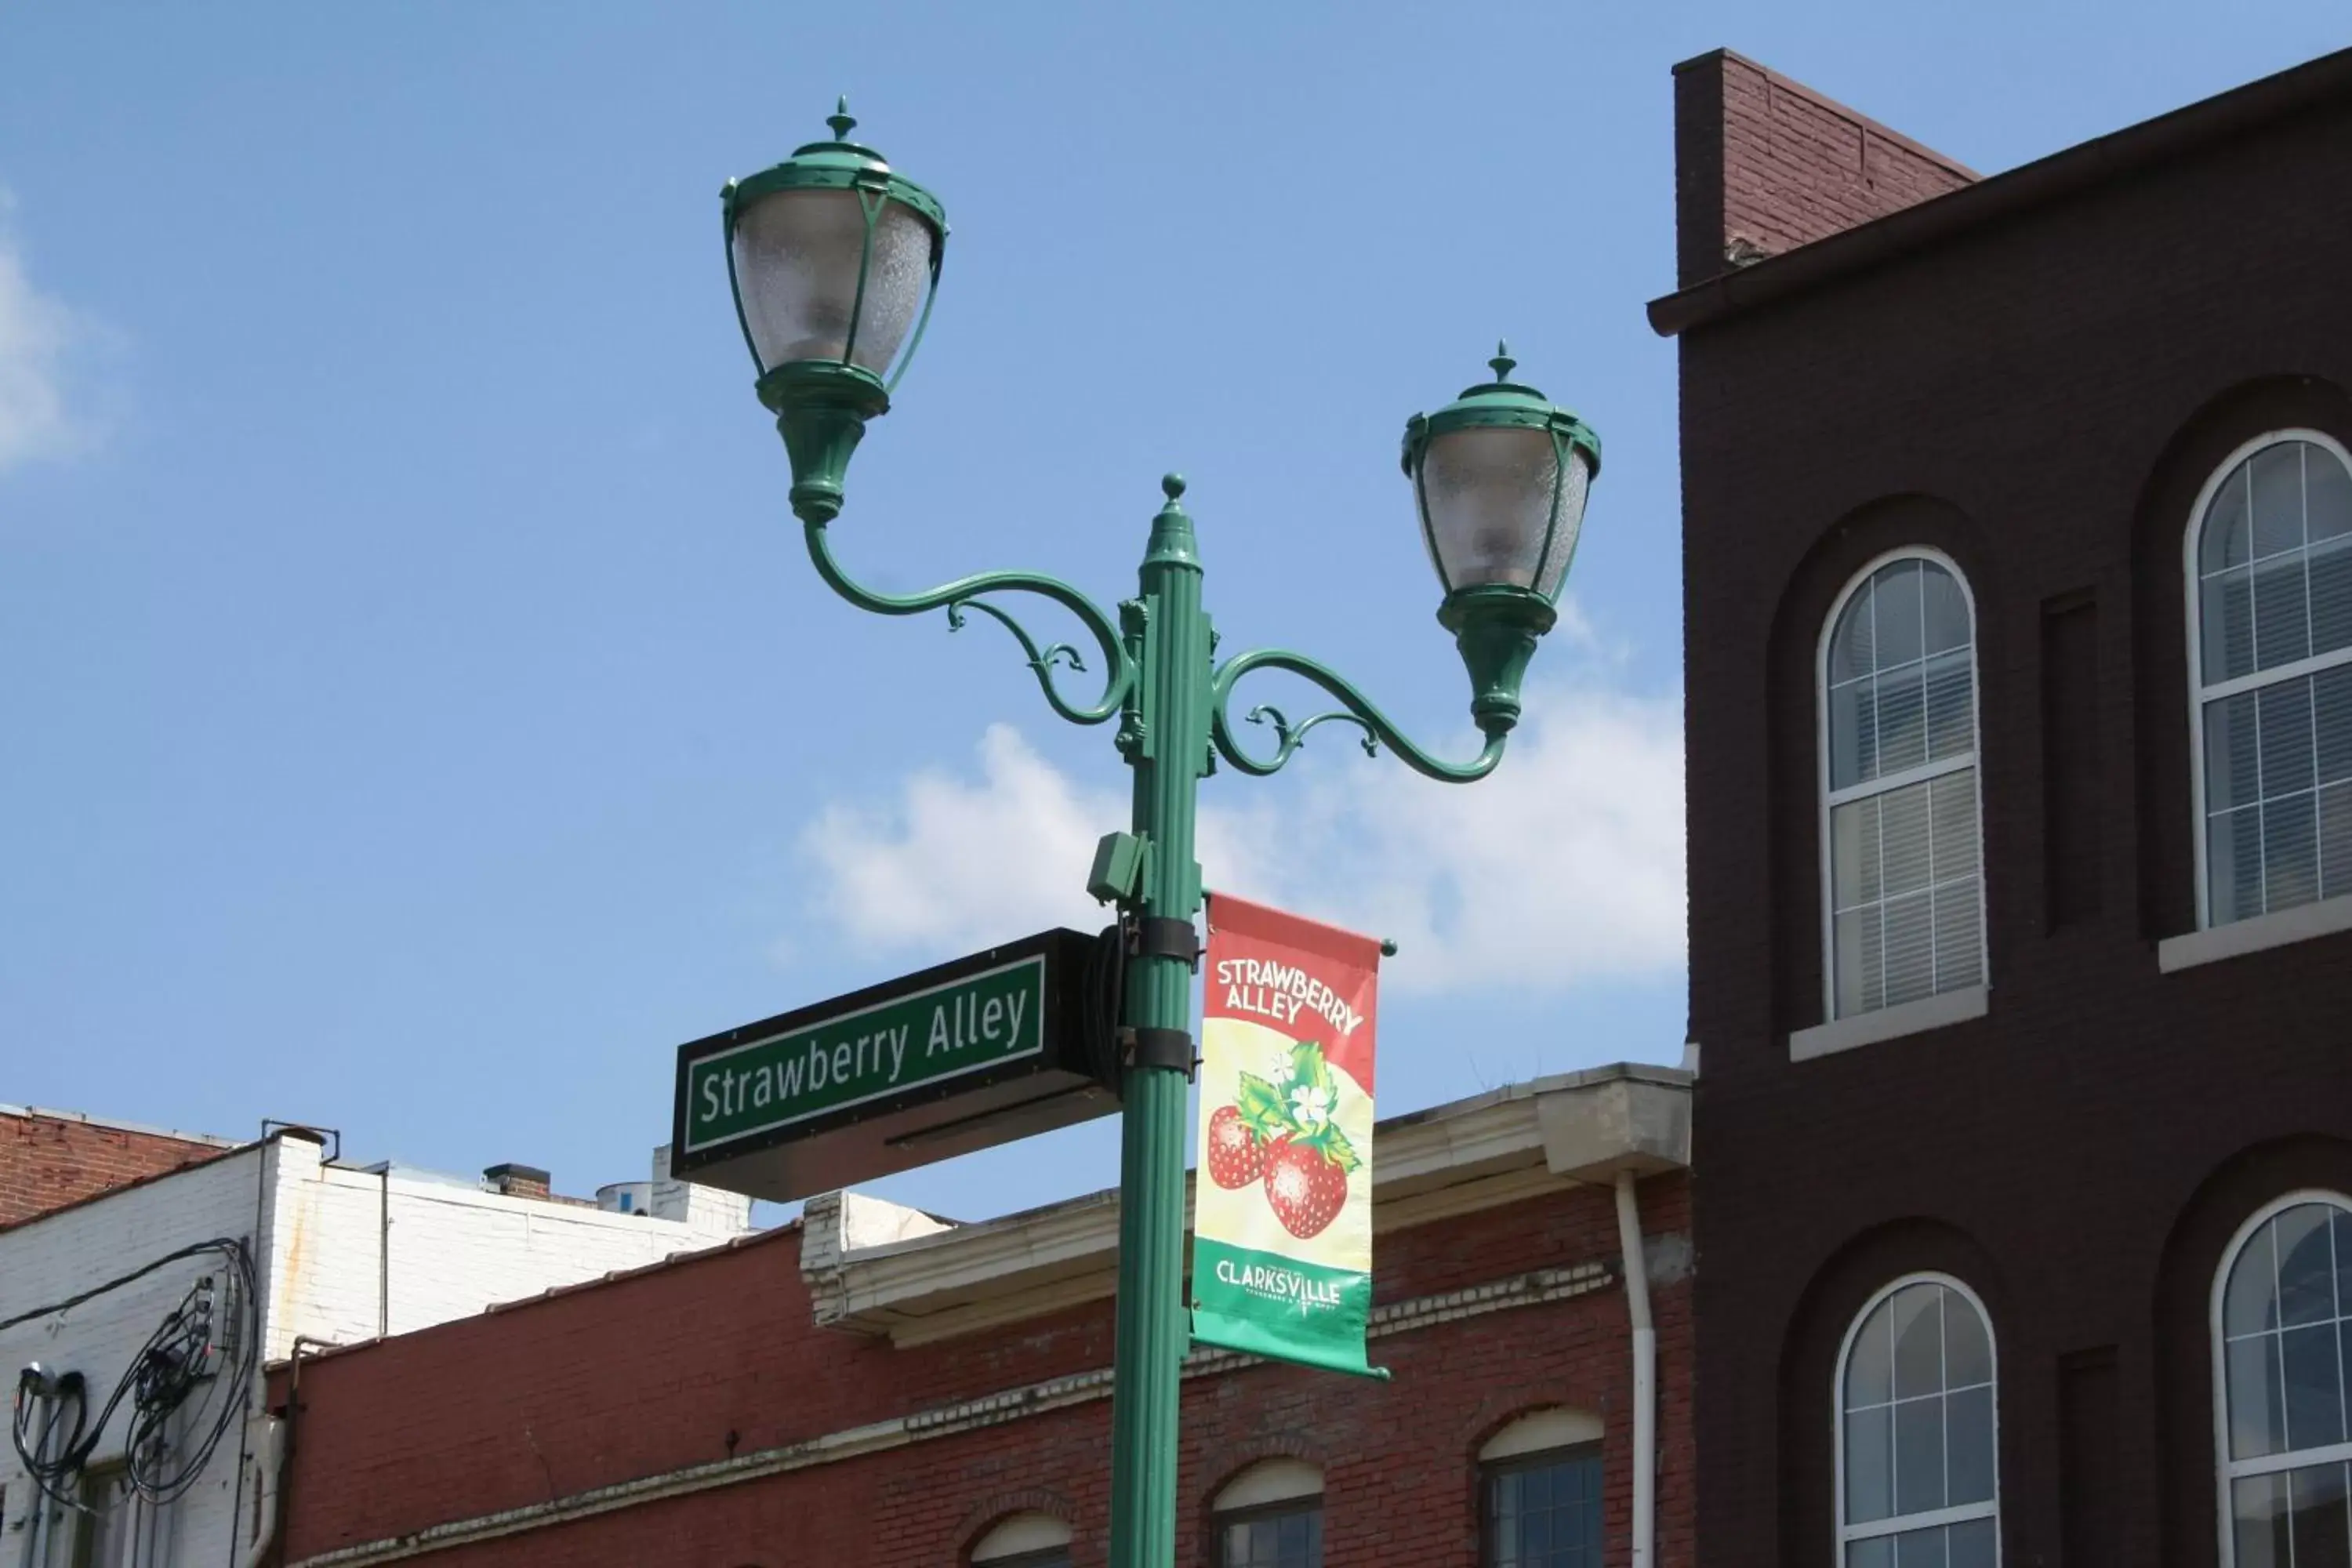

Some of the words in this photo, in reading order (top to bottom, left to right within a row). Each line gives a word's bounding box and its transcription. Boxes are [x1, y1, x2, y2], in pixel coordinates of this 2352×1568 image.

[1217, 958, 1364, 1036] STRAWBERRY
[1225, 985, 1304, 1025] ALLEY
[701, 1022, 909, 1123] Strawberry
[926, 989, 1027, 1058] Alley
[1216, 1260, 1341, 1318] CLARKSVILLE
